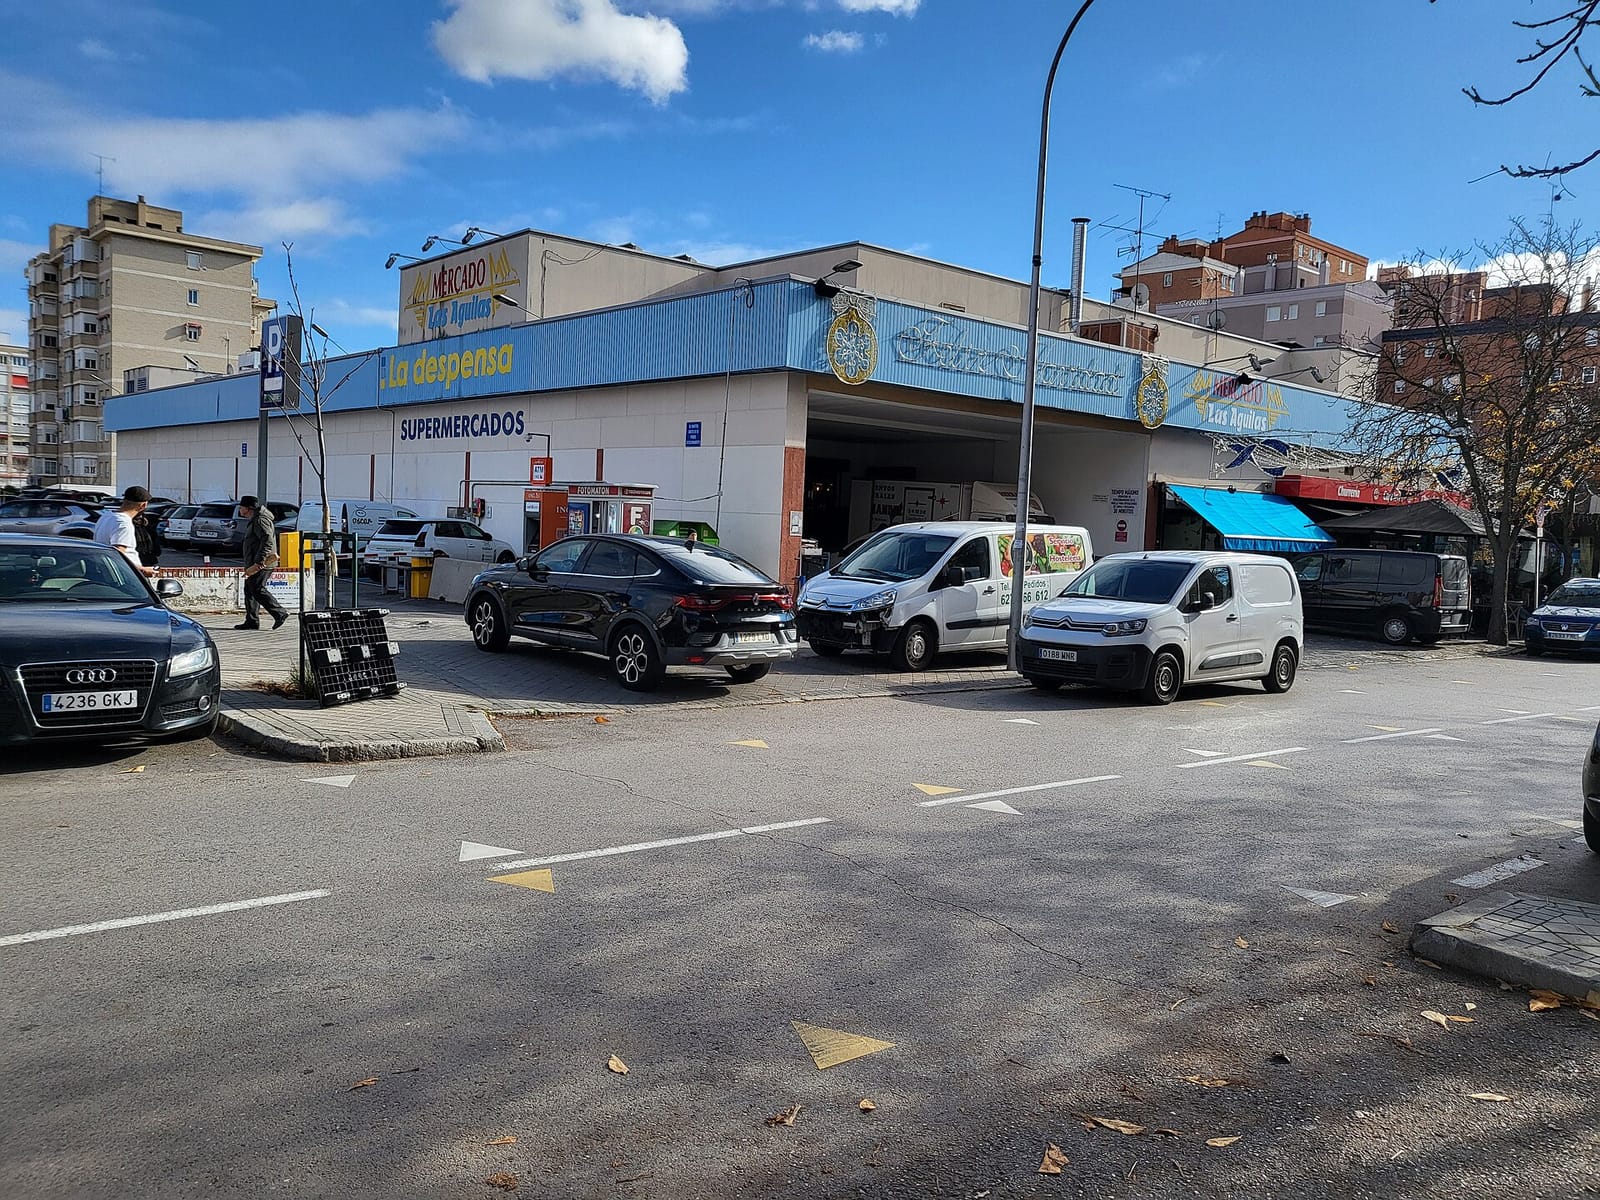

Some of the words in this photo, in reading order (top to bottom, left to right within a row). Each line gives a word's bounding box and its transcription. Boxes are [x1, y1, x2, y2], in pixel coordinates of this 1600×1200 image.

[432, 258, 486, 298] MERCADO
[427, 305, 448, 329] Las
[389, 355, 409, 388] La
[413, 344, 513, 390] despensa
[400, 410, 525, 440] SUPERMERCADOS
[1208, 403, 1228, 426] Las
[1230, 407, 1268, 432] Aguilas
[577, 486, 610, 495] FOTOMATON
[630, 506, 643, 526] F
[1049, 537, 1074, 545] Servicio
[1035, 590, 1049, 601] 612
[54, 695, 97, 709] 4236
[102, 692, 134, 707] GKJ
